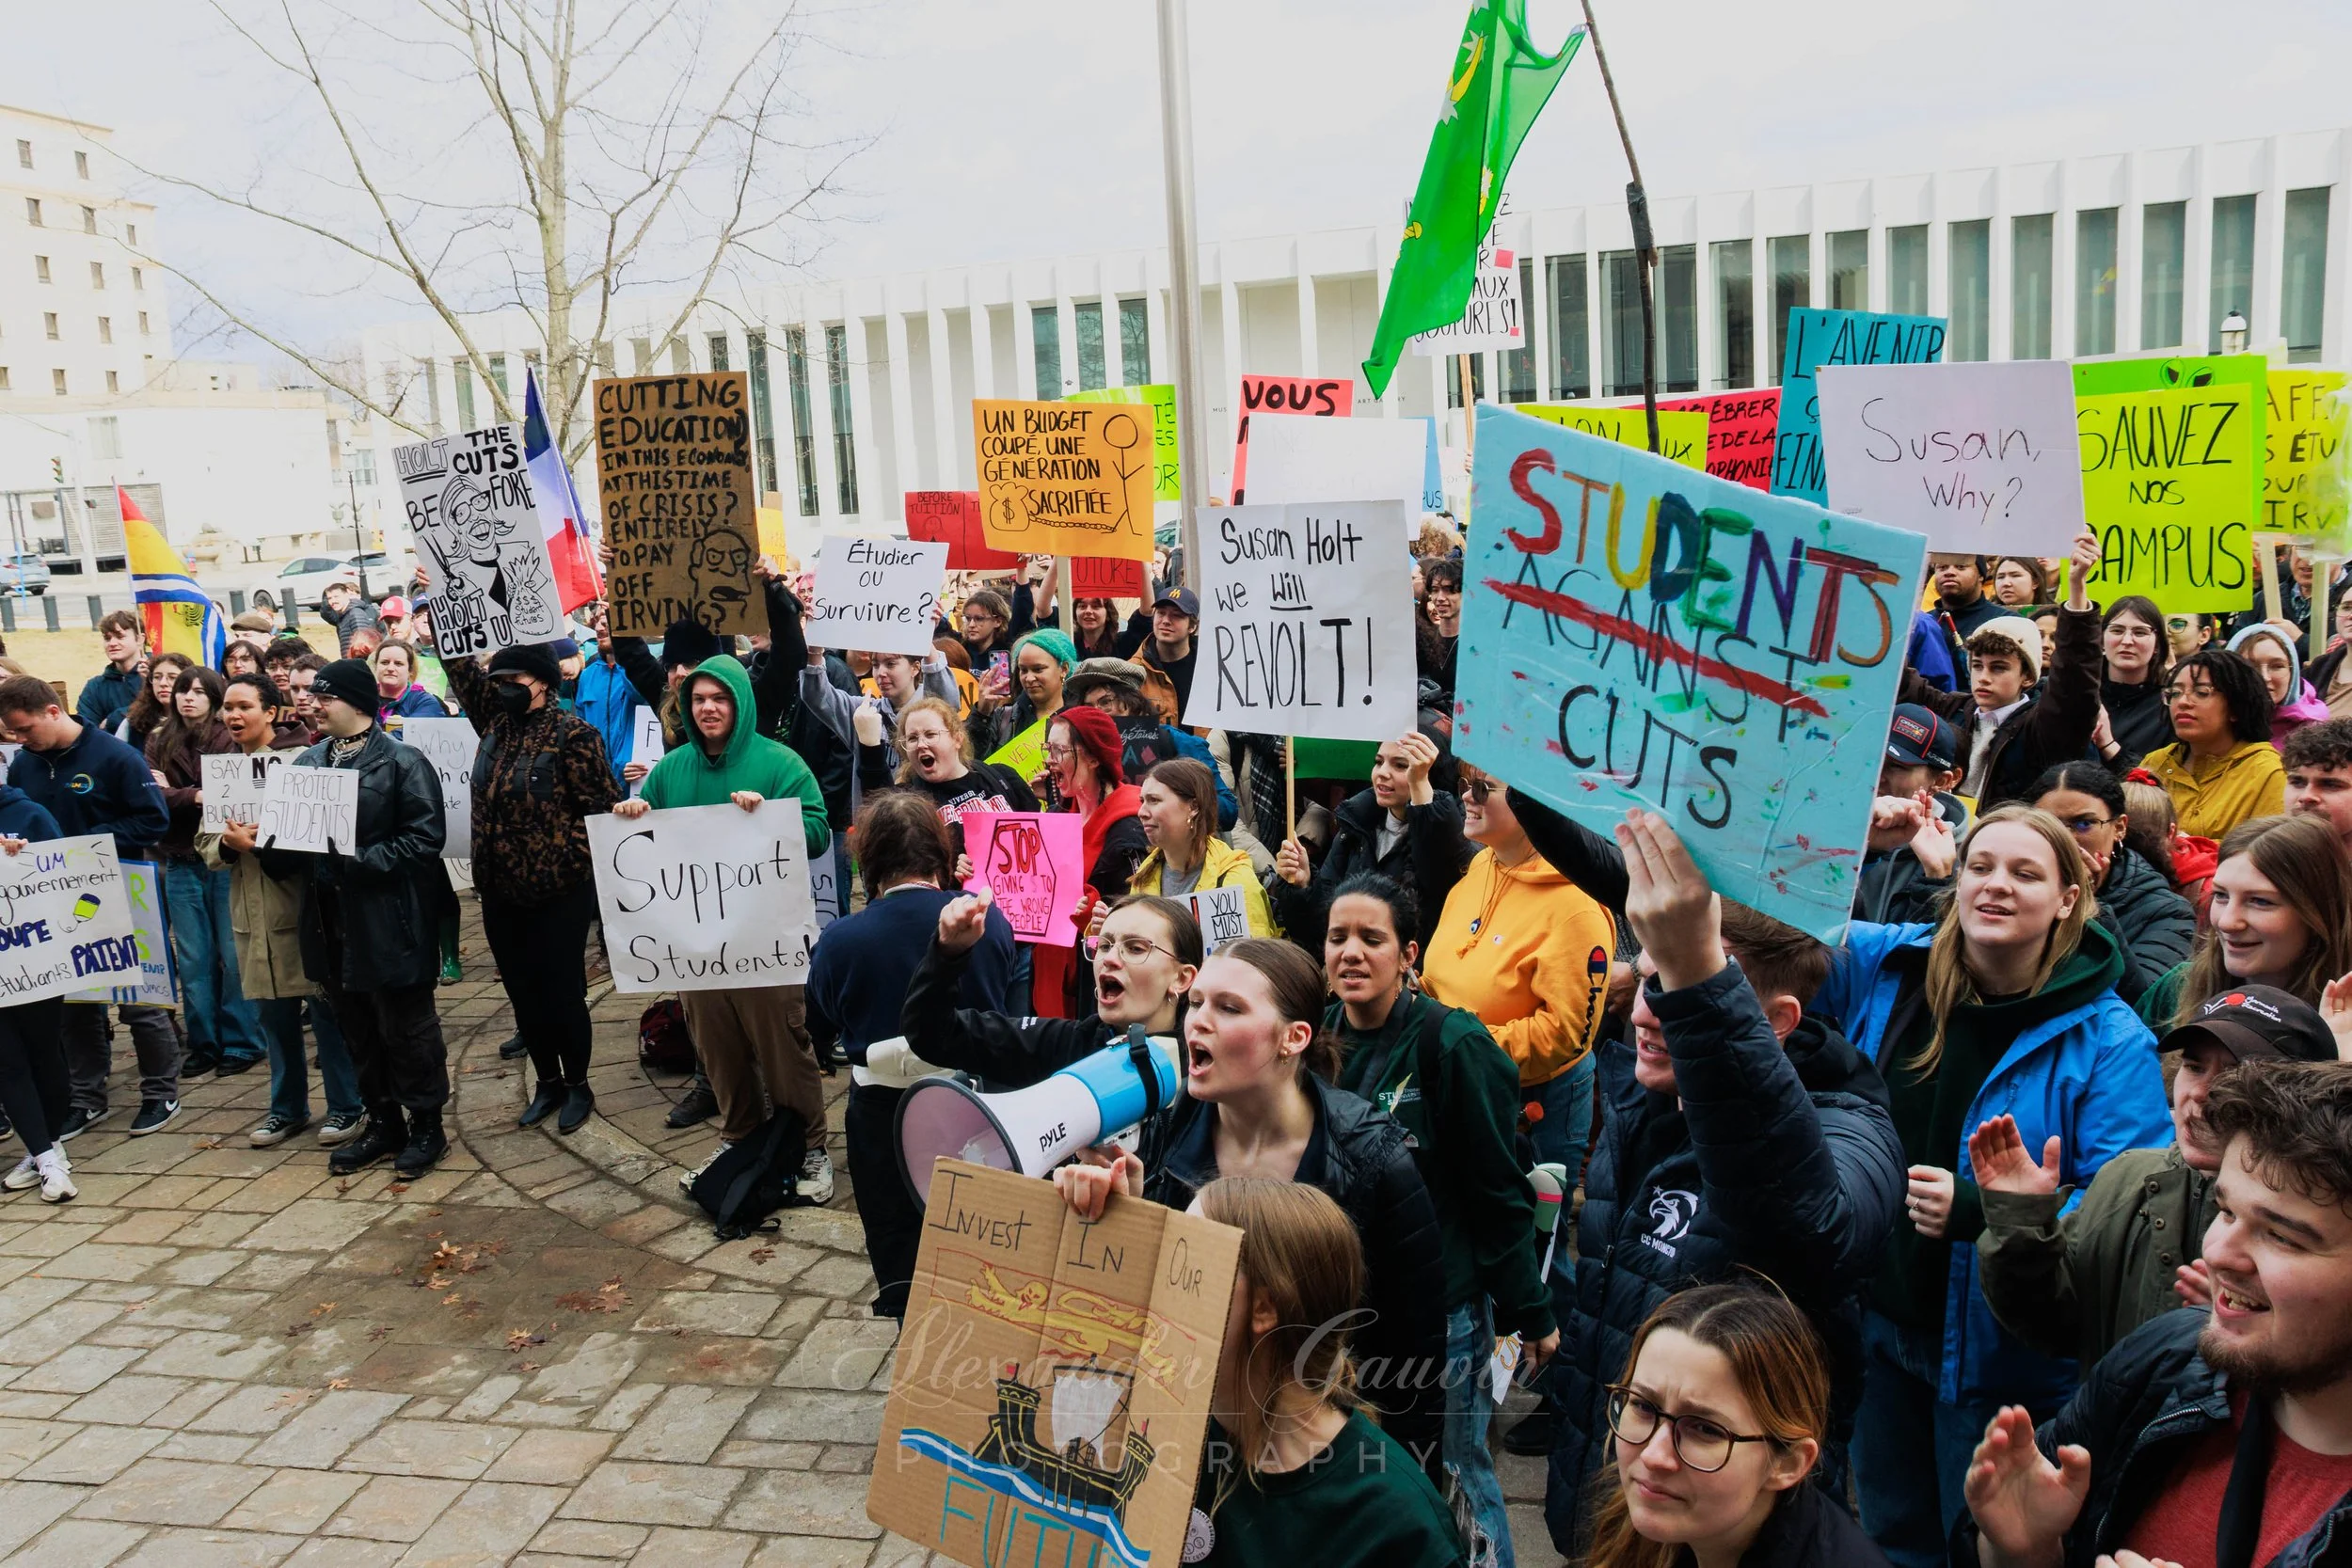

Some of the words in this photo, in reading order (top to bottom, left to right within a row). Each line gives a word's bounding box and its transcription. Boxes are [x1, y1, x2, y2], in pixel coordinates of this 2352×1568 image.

[599, 378, 740, 414] CUTTING
[1243, 380, 1340, 417] VOUS
[983, 409, 1015, 434] UN
[1025, 408, 1092, 434] BUDGET
[1862, 398, 2041, 463] Susan,
[394, 438, 449, 476] HOLT
[465, 426, 513, 448] THE
[981, 435, 1041, 458] COUPÉ,
[1045, 436, 1086, 455] UNE
[2077, 403, 2240, 472] SAUVEZ
[453, 444, 519, 476] CUTS
[601, 451, 628, 471] IN
[631, 449, 670, 467] THIS
[984, 457, 1101, 482] GÉNÉRATION
[624, 472, 674, 493] THIS
[675, 471, 732, 490] TIME
[2129, 480, 2185, 504] NOS
[405, 494, 441, 532] BE
[489, 470, 537, 511] FORE
[608, 496, 631, 520] OF
[639, 491, 739, 526] CRISIS?
[909, 500, 961, 515] TUITION
[917, 492, 953, 503] BEFORE
[1028, 488, 1113, 517] SACRIFIÉE
[1923, 472, 2023, 526] Why?
[610, 517, 712, 545] ENTIRELY
[1221, 517, 1295, 564] Susan
[1307, 516, 1363, 565] Holt
[634, 543, 675, 567] PAY
[847, 539, 924, 565] Étudier
[1502, 447, 1899, 669] STUDENTS
[1071, 557, 1137, 584] UTURE
[614, 572, 656, 599] OFF
[1216, 582, 1248, 612] we
[430, 588, 488, 631] HOLT
[612, 596, 726, 635] IRVING?
[441, 624, 487, 656] CUTS
[1502, 552, 1820, 742] AGAINST
[1216, 617, 1373, 711] REVOLT!
[211, 759, 243, 780] SAY
[1558, 685, 1738, 830] CUTS
[221, 784, 230, 799] 2
[282, 773, 344, 802] PROTECT
[206, 802, 256, 825] BUDGET
[264, 800, 351, 847] STUDENTS
[994, 822, 1041, 876] STOP
[613, 830, 790, 924] Support
[993, 876, 1025, 895] GIVING
[1041, 875, 1053, 893] TO
[997, 896, 1013, 915] THE
[1021, 897, 1050, 915] WRONG
[1209, 891, 1236, 915] YOU
[1009, 912, 1042, 931] PEOPLE
[1212, 913, 1243, 939] MUST
[629, 933, 813, 983] Students!
[1040, 1122, 1067, 1152] PYLE
